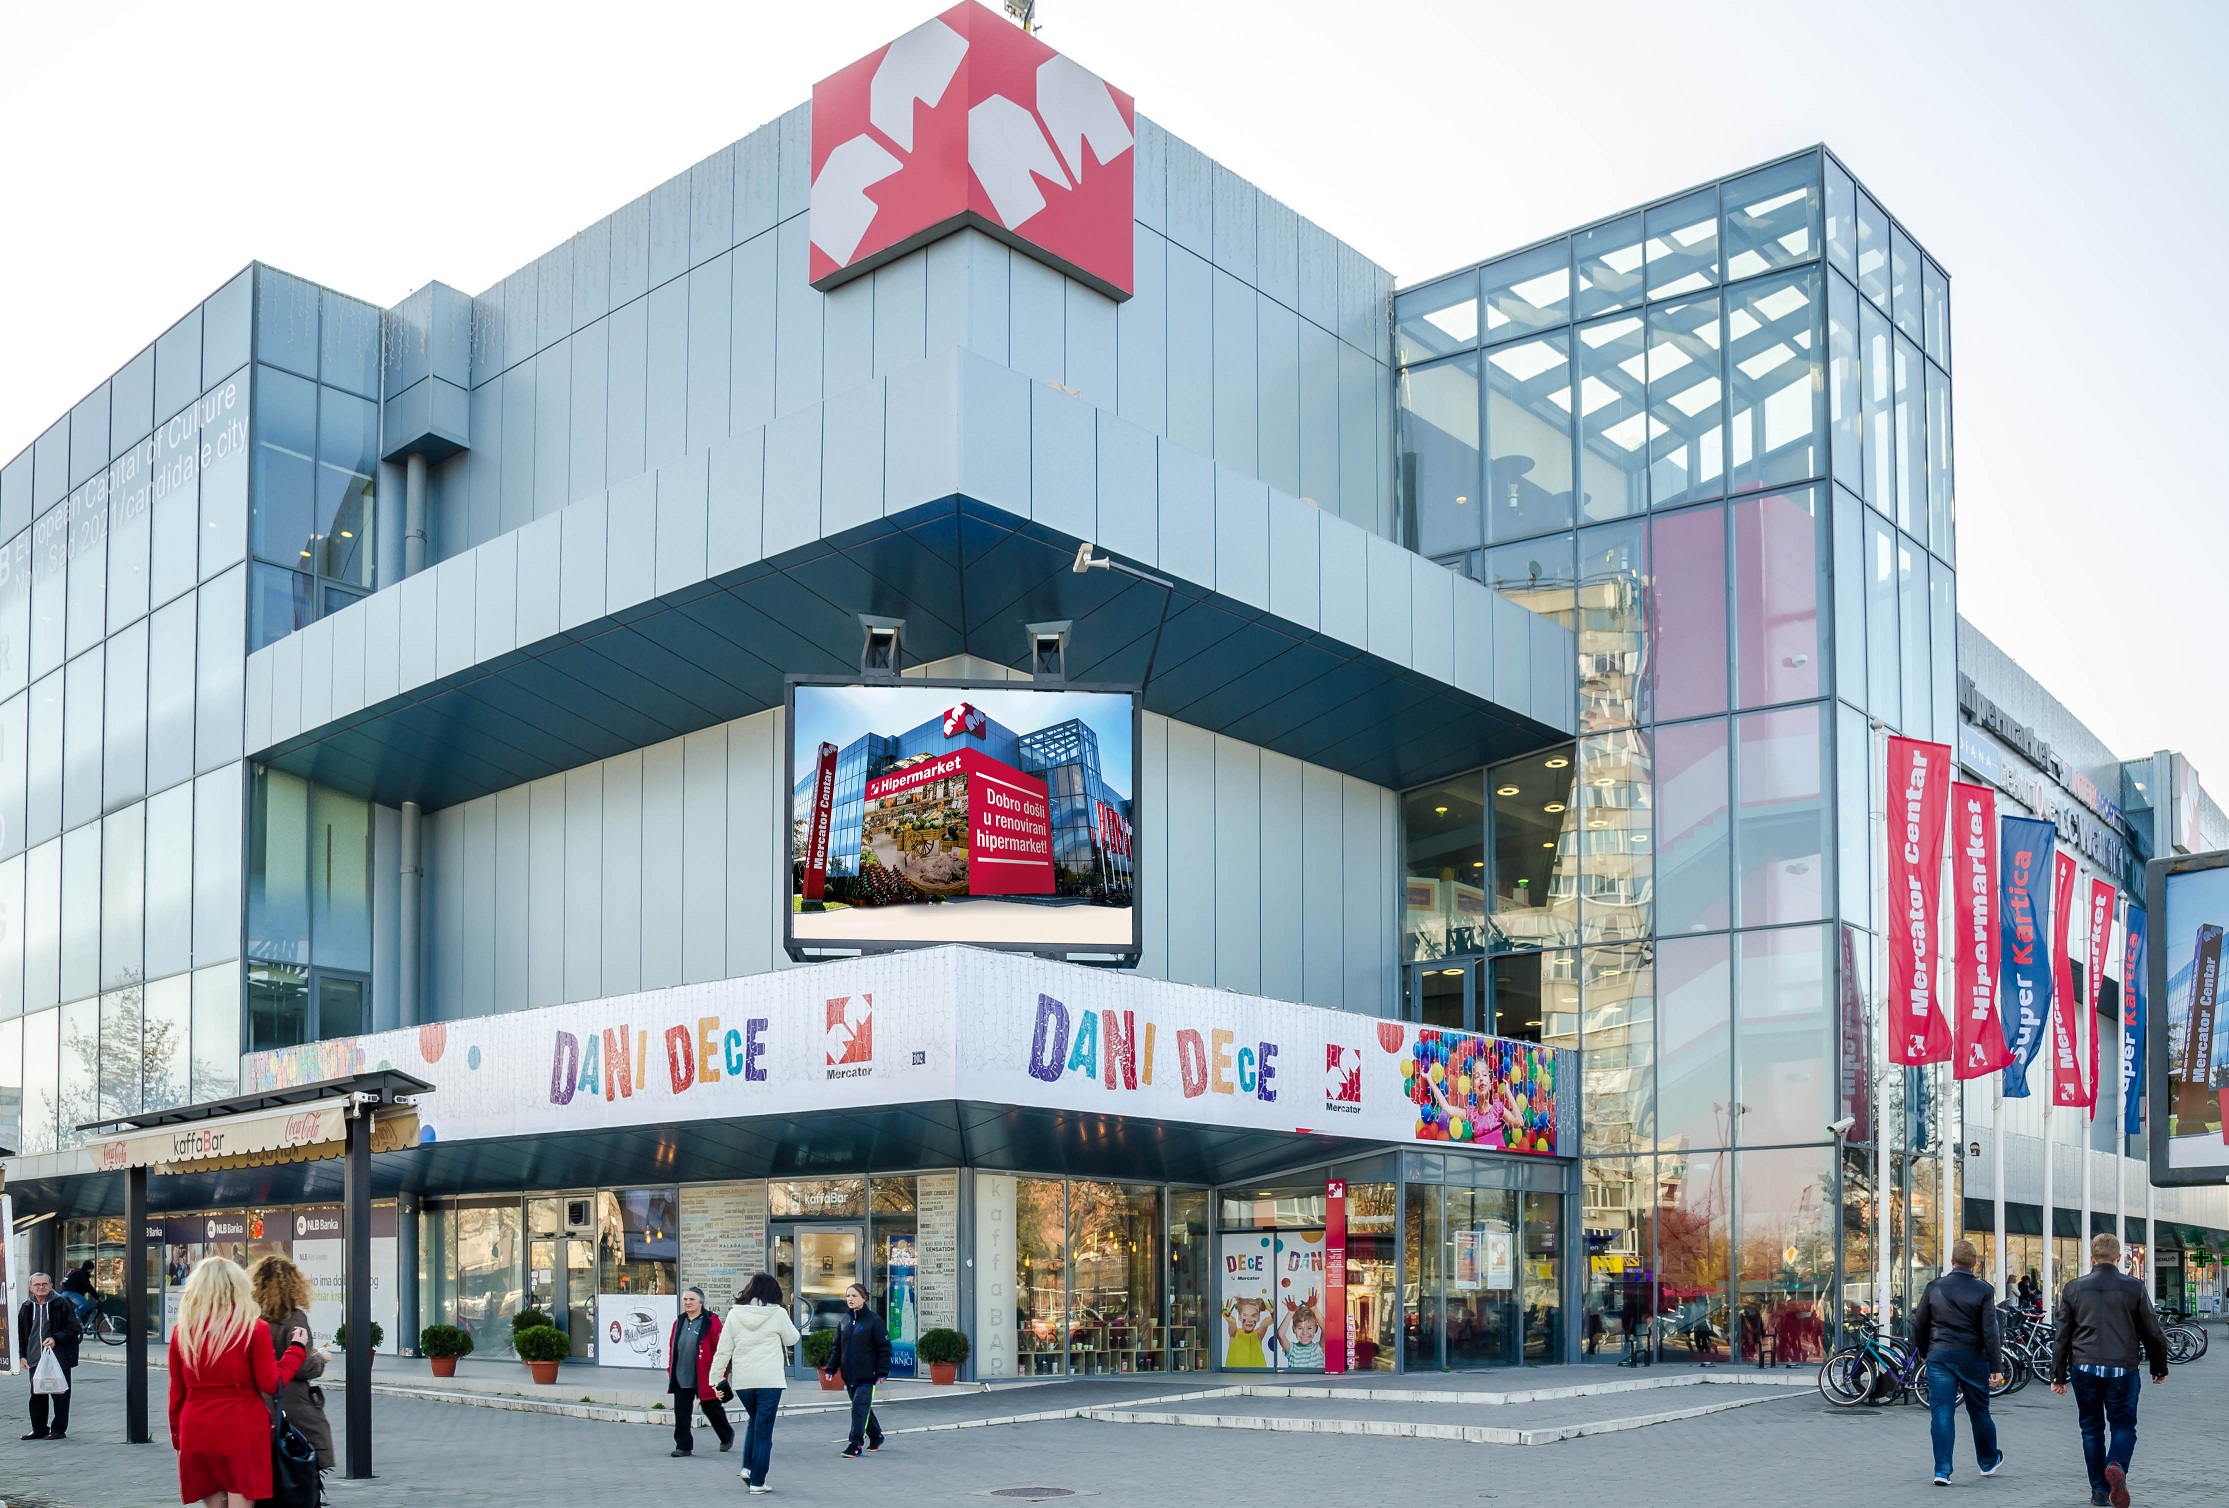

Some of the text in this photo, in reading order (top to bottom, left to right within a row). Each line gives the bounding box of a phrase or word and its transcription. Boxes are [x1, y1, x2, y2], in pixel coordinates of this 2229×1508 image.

[15, 383, 236, 563] European Capital of Culture
[16, 417, 249, 596] Novi Sad 2021/candidate city
[881, 755, 961, 792] Hipermarket
[987, 788, 1045, 818] Dobro došli
[814, 768, 833, 870] Mercator Centar
[983, 812, 1046, 836] u renovirani
[976, 829, 1047, 854] hipermarket!
[1905, 750, 1930, 1017] Mercator Centar
[1966, 799, 1992, 1020] Hipermarket
[2009, 850, 2040, 1065] Super Kartica
[2192, 956, 2216, 1083] Mercator Centar
[550, 1016, 768, 1105] DANI DECE
[1028, 993, 1279, 1102] DANI DECE
[826, 1067, 872, 1080] Mercator
[1326, 1102, 1361, 1115] Mercator
[173, 1130, 224, 1156] kaffaBar
[804, 1192, 848, 1205] kaffaBar
[149, 1227, 163, 1237] Banka
[216, 1223, 243, 1234] NLB Banka
[307, 1219, 338, 1231] NLB Banka
[1226, 1253, 1263, 1273] DECE
[1288, 1250, 1326, 1271] DAN
[320, 1274, 331, 1286] ima
[990, 1178, 1004, 1375] kaffaBAR
